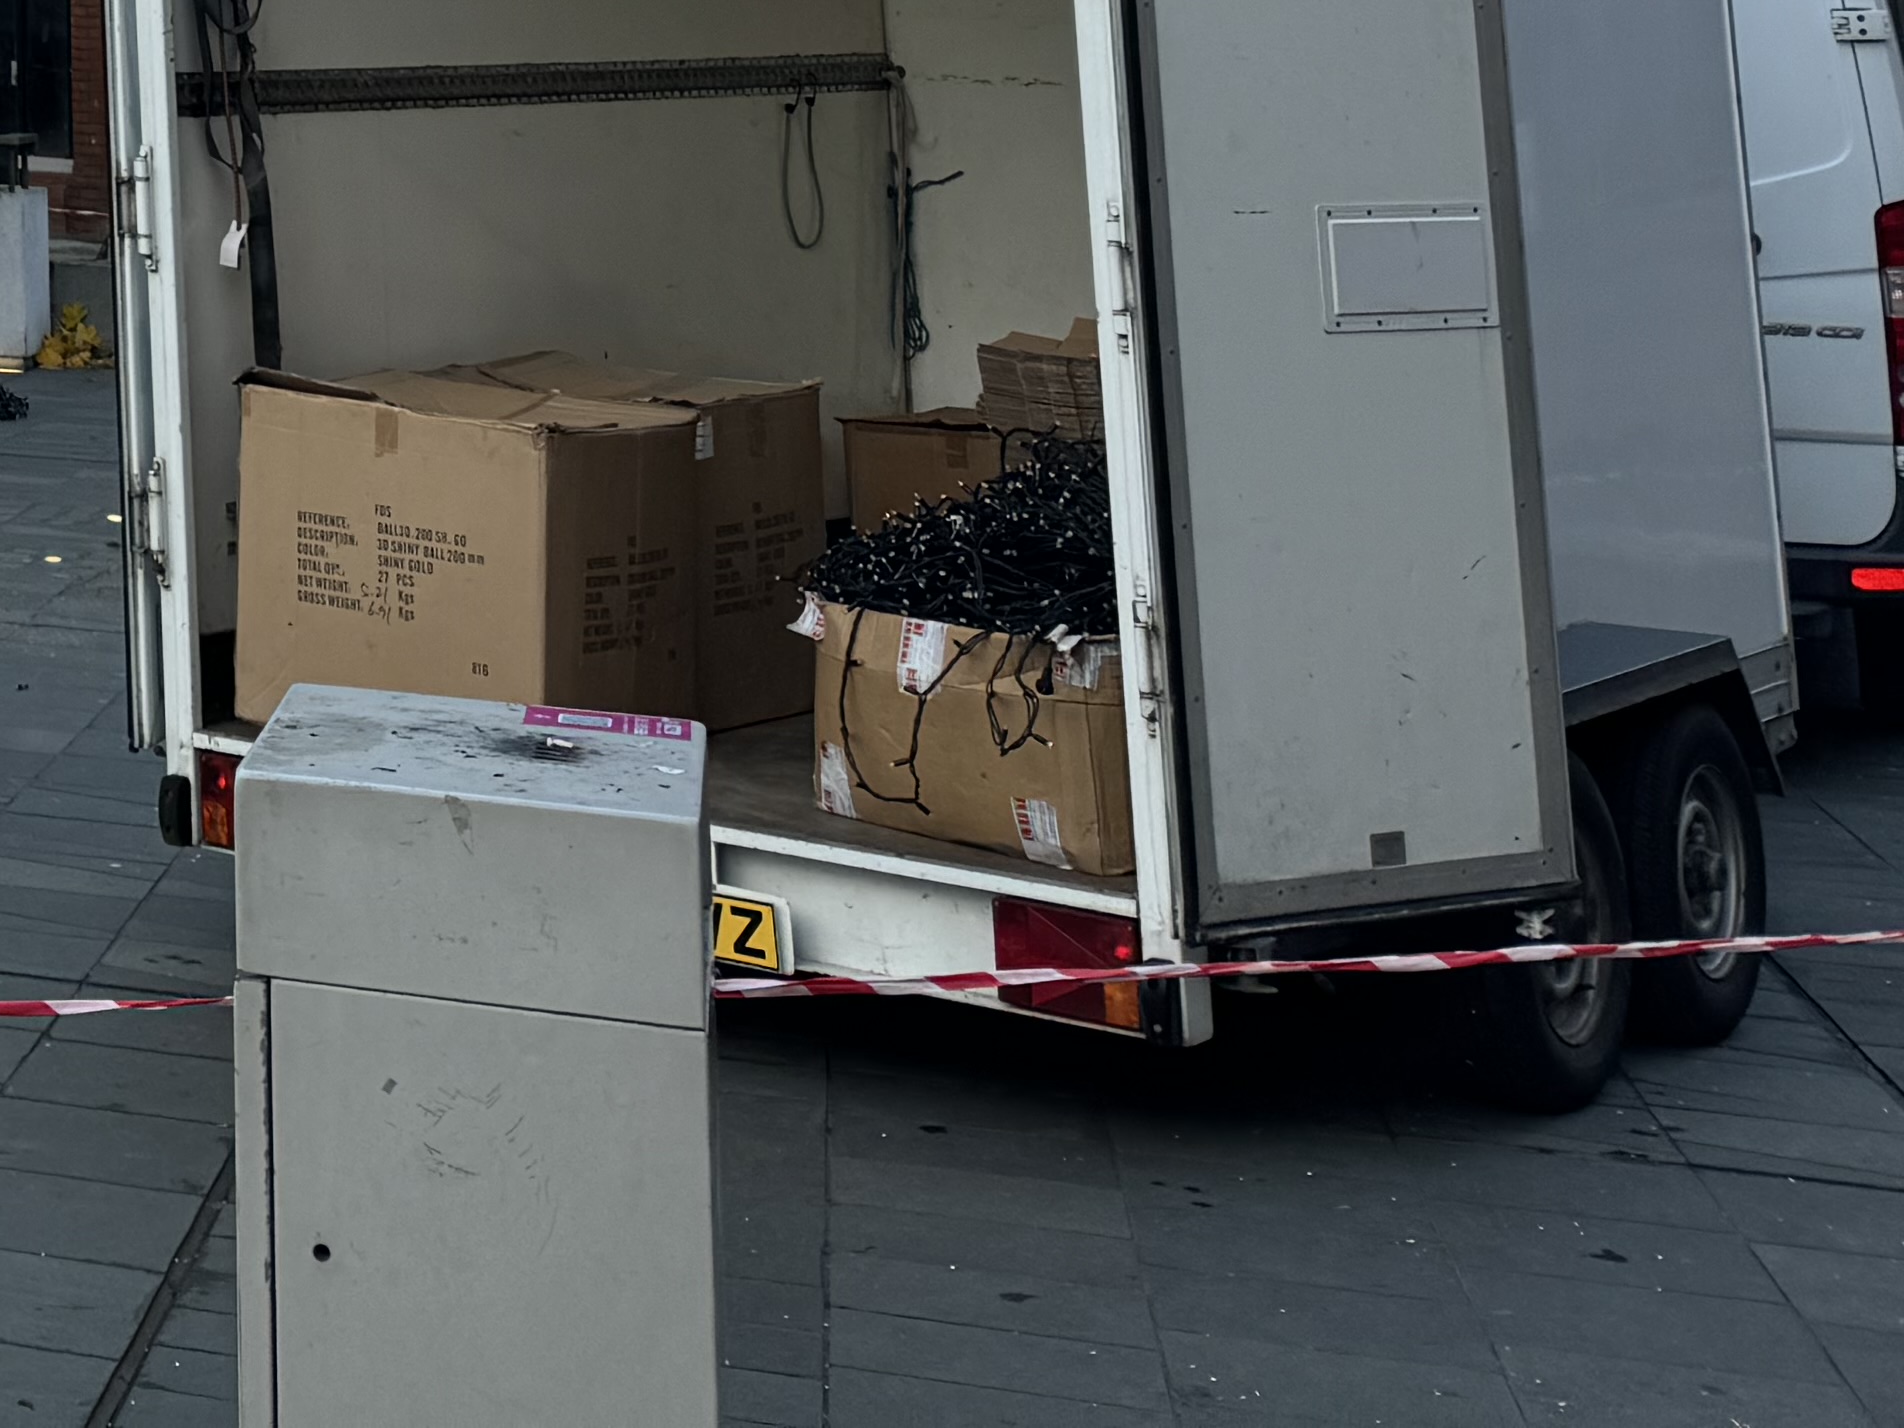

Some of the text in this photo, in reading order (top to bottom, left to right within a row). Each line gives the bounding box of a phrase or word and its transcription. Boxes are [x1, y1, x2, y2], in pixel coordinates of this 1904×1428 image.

[390, 540, 420, 557] SHINY
[423, 545, 445, 561] BALL
[377, 555, 406, 571] SHINY
[408, 559, 434, 575] GOLD
[377, 571, 389, 584] 27
[396, 573, 415, 588] PCS
[297, 590, 326, 606] GROSS
